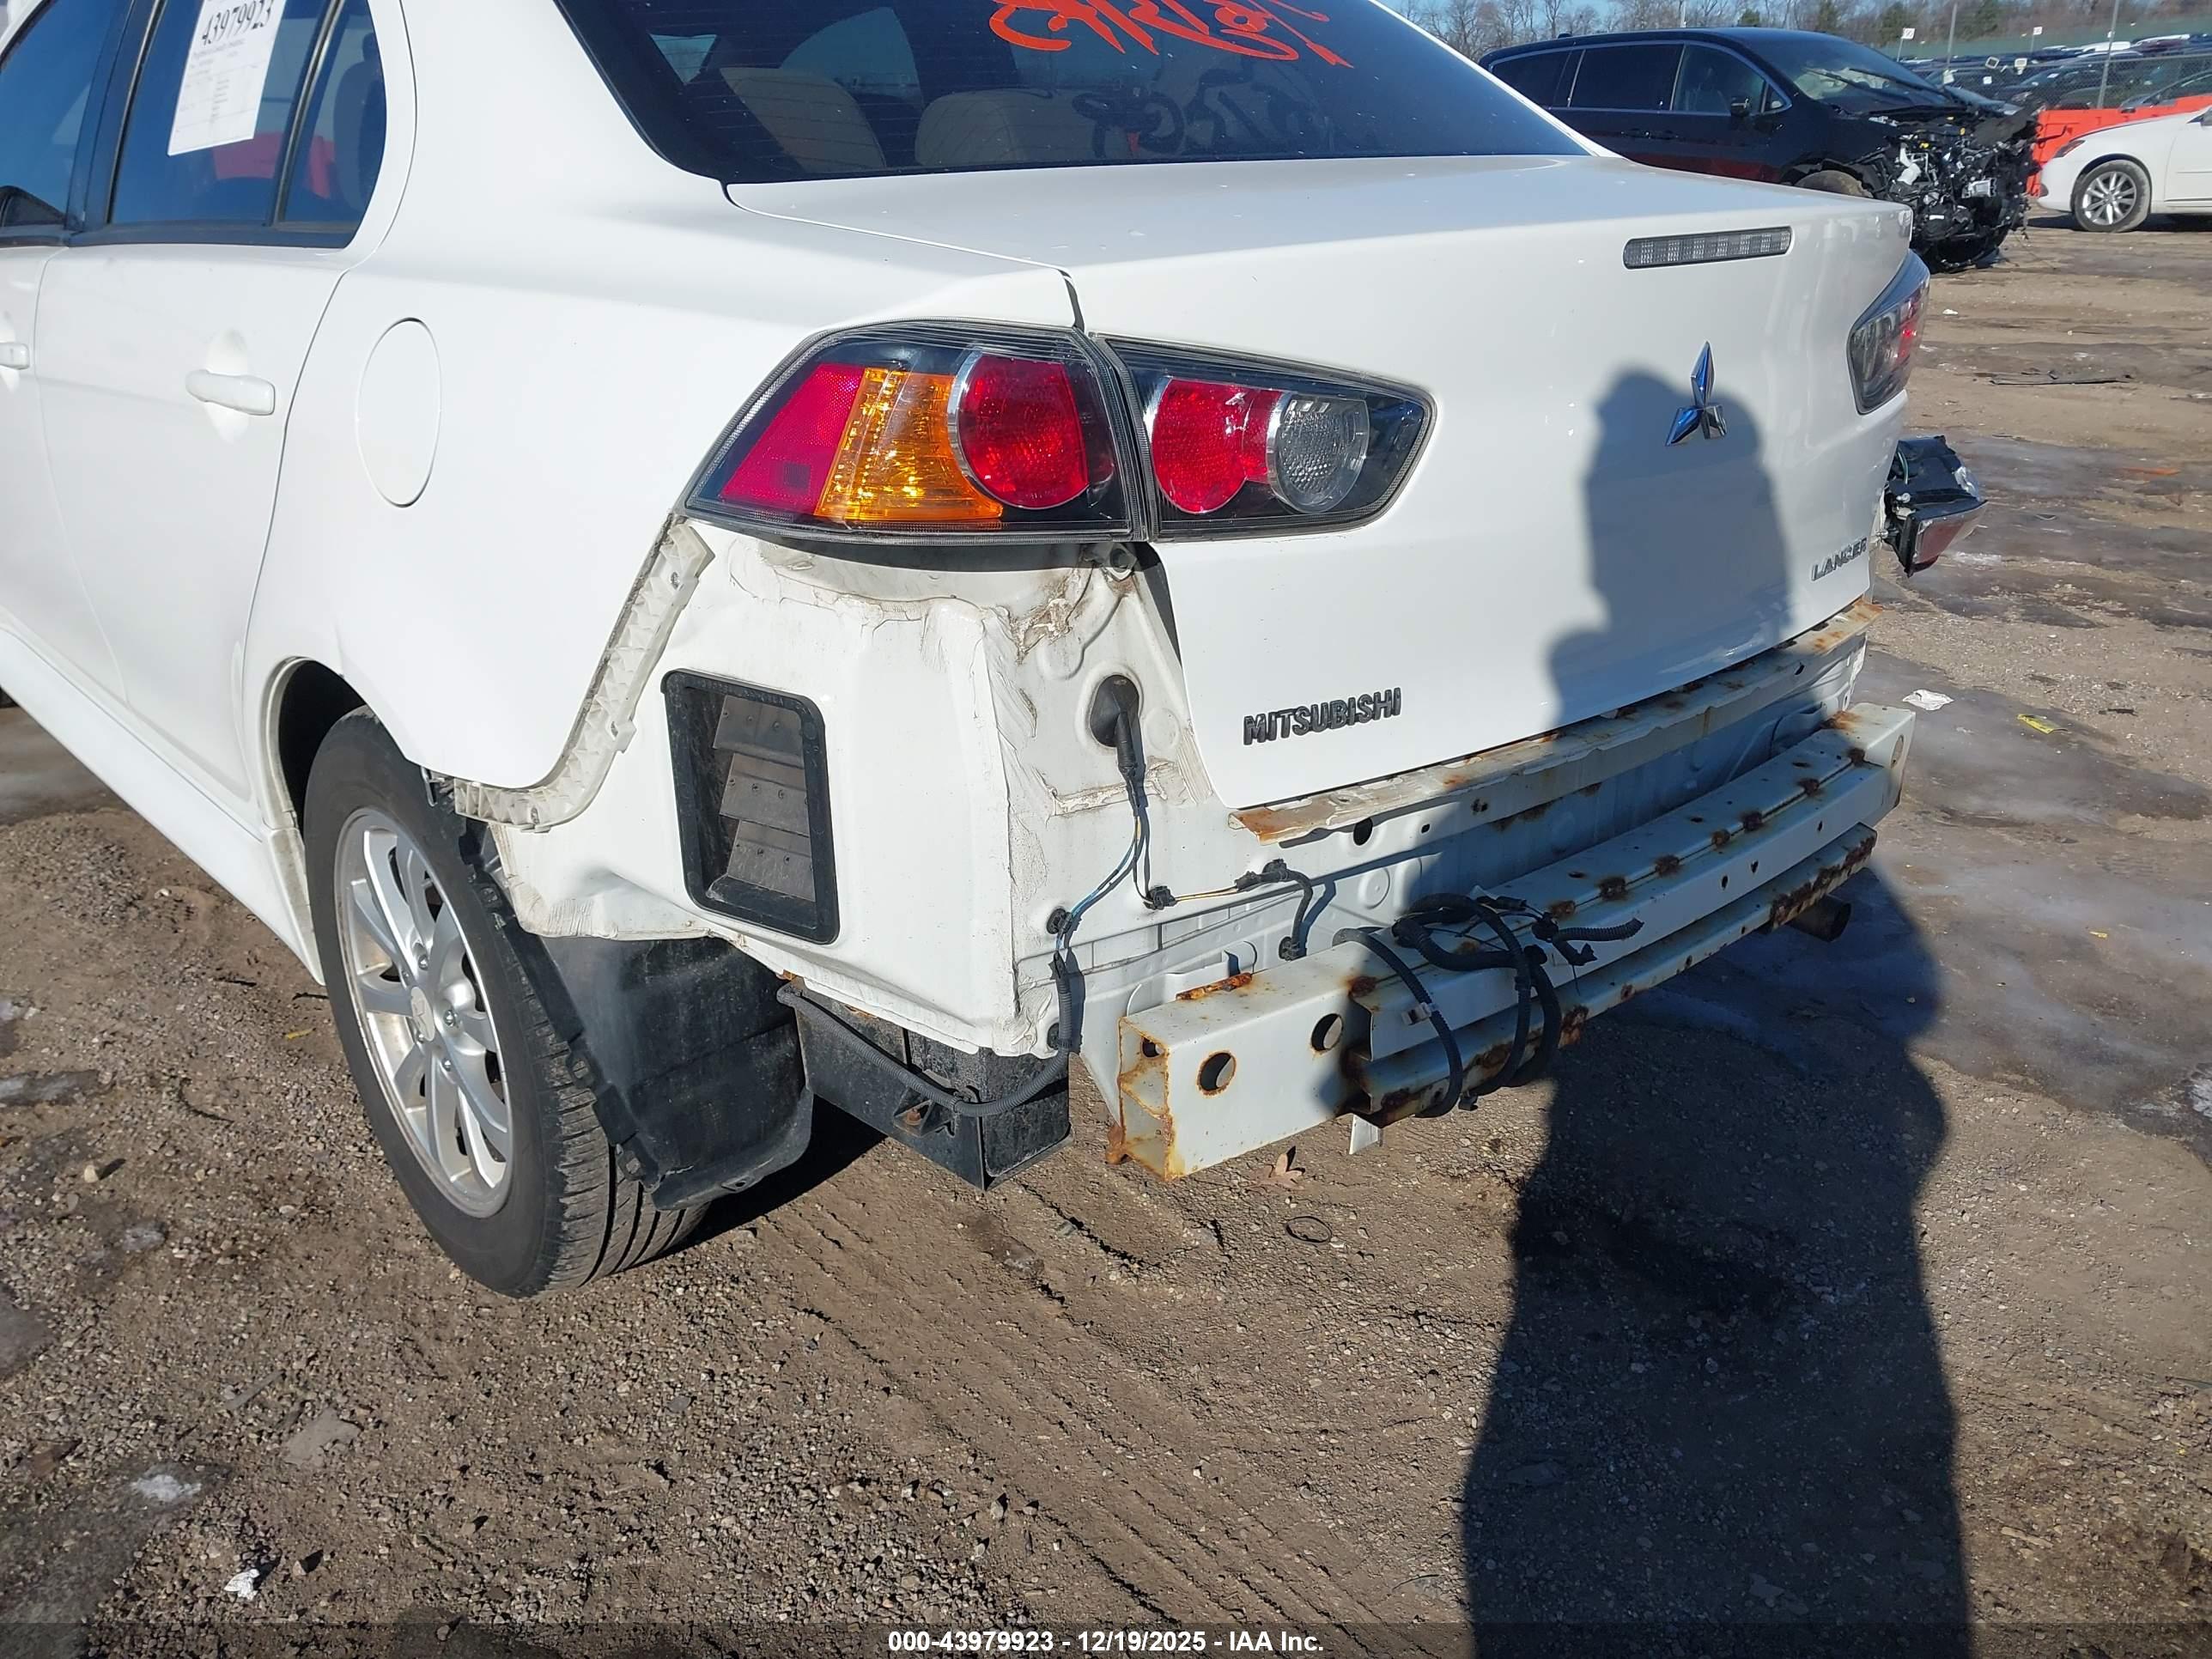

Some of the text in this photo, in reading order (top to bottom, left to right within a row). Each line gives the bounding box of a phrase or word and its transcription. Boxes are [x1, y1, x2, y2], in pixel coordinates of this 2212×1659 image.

[202, 0, 275, 46] 43979923
[1812, 537, 1867, 581] LANCER
[1243, 687, 1401, 745] MITSUBISHI
